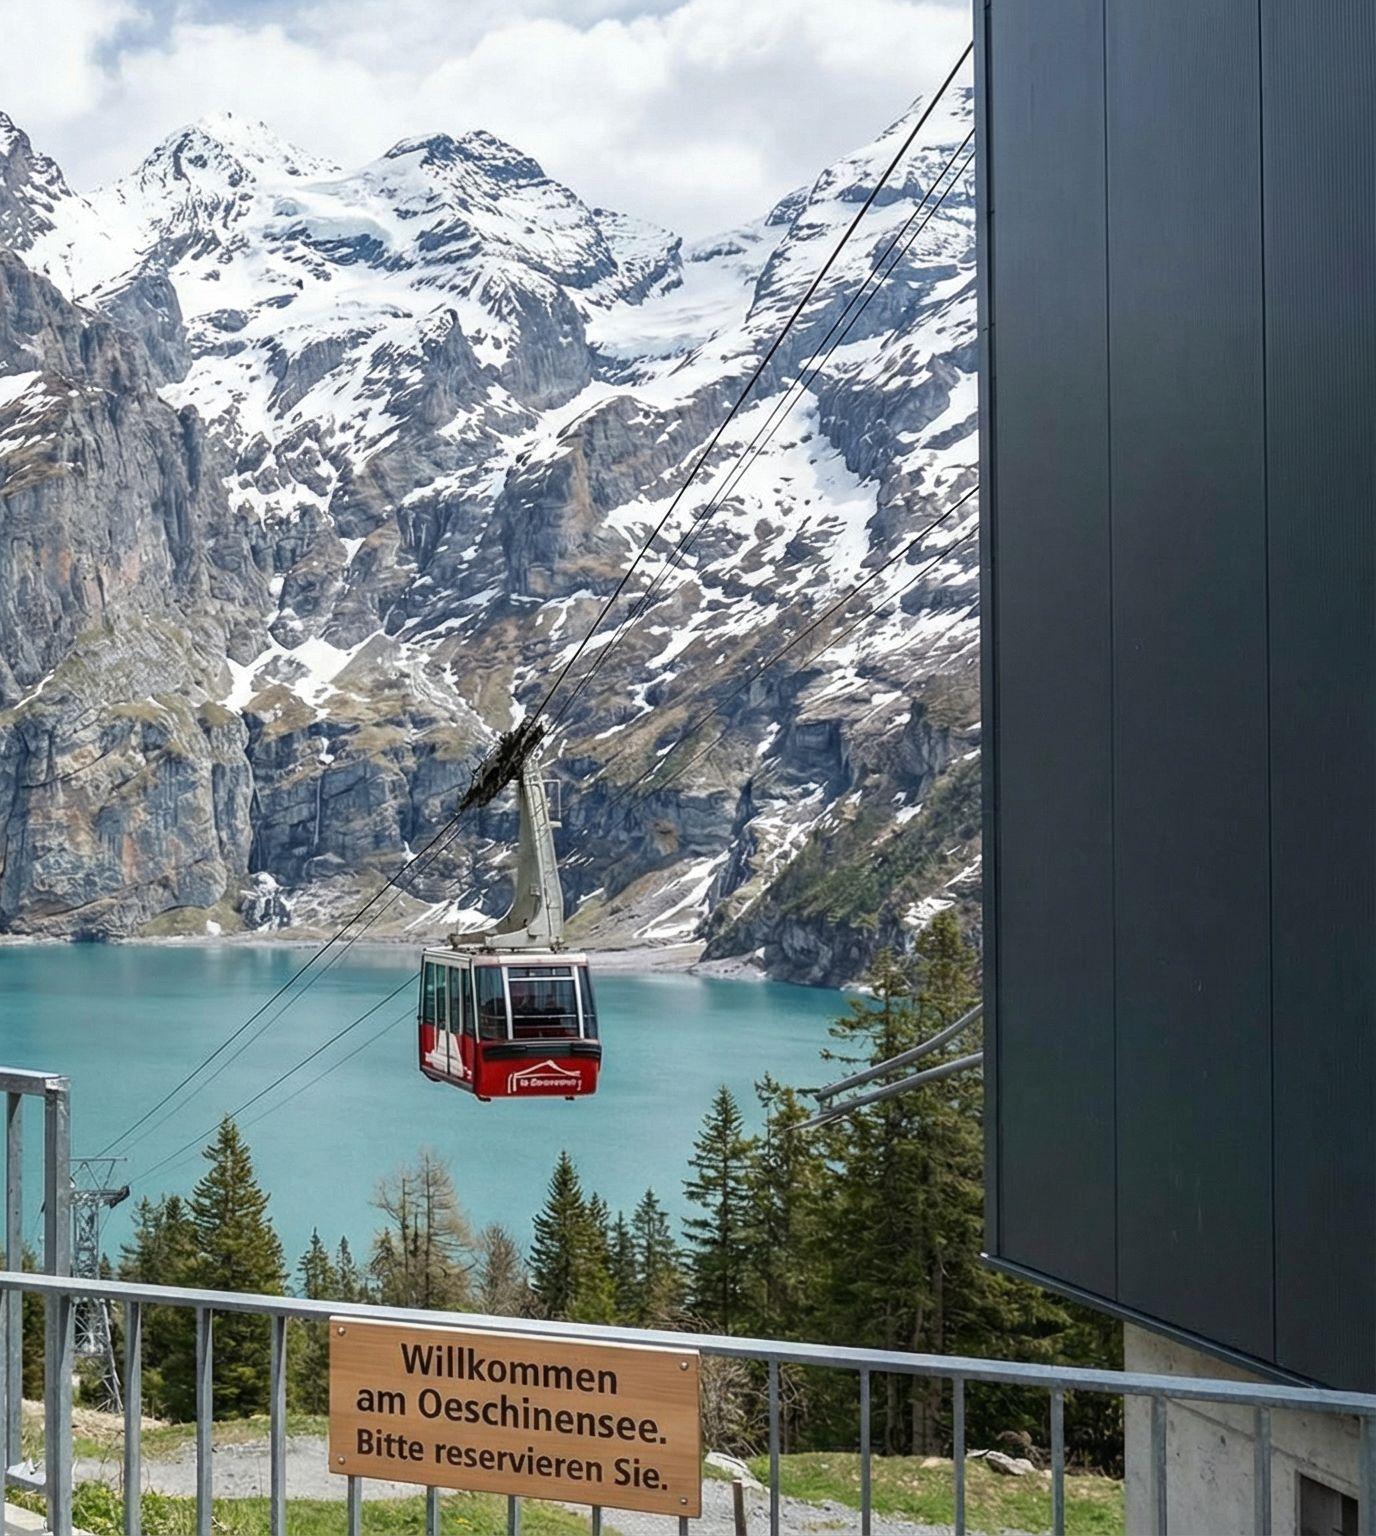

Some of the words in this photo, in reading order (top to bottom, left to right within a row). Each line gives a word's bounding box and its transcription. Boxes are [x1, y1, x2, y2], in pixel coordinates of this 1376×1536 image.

[401, 1342, 618, 1395] Willkommen
[356, 1388, 406, 1416] am
[418, 1388, 668, 1445] Oeschinensee.
[357, 1428, 424, 1462] Bitte
[435, 1443, 603, 1483] reservieren
[614, 1457, 669, 1491] Sie.
